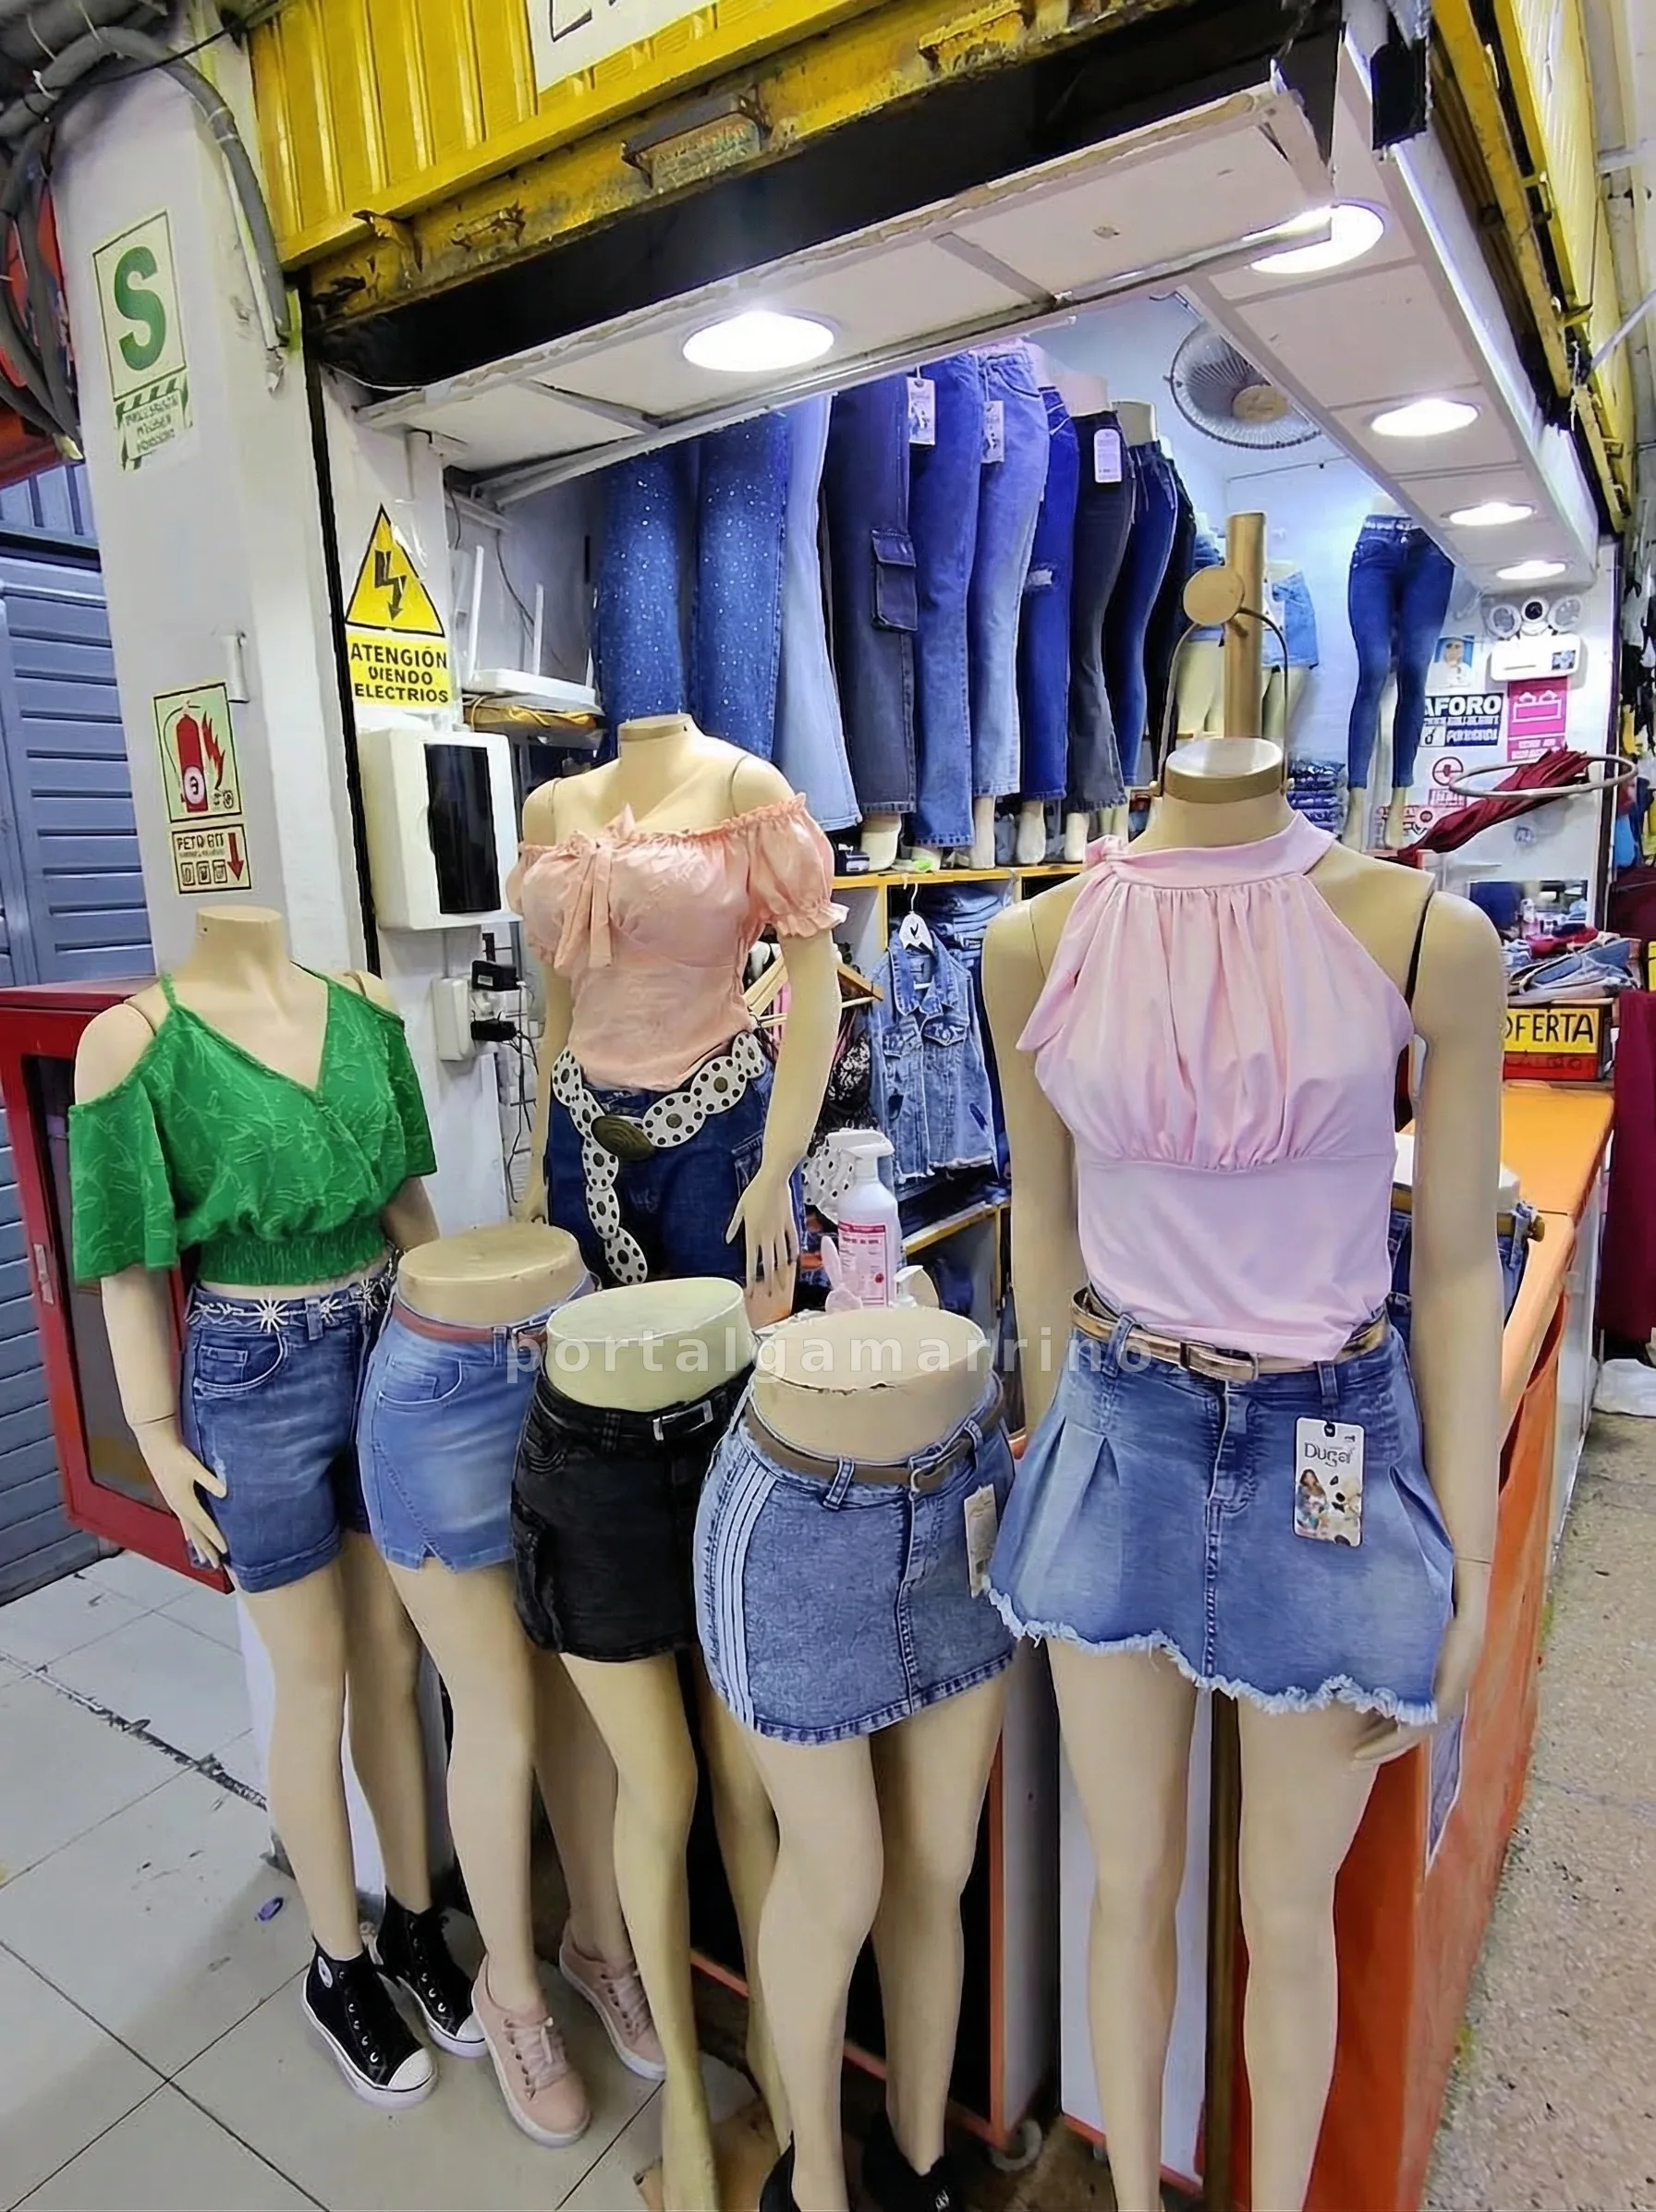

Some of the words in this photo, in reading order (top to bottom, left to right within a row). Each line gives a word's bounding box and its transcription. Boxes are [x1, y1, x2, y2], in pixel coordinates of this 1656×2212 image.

[114, 246, 166, 371] S
[354, 684, 448, 703] ELECTRIOS
[1425, 695, 1503, 717] AFORO
